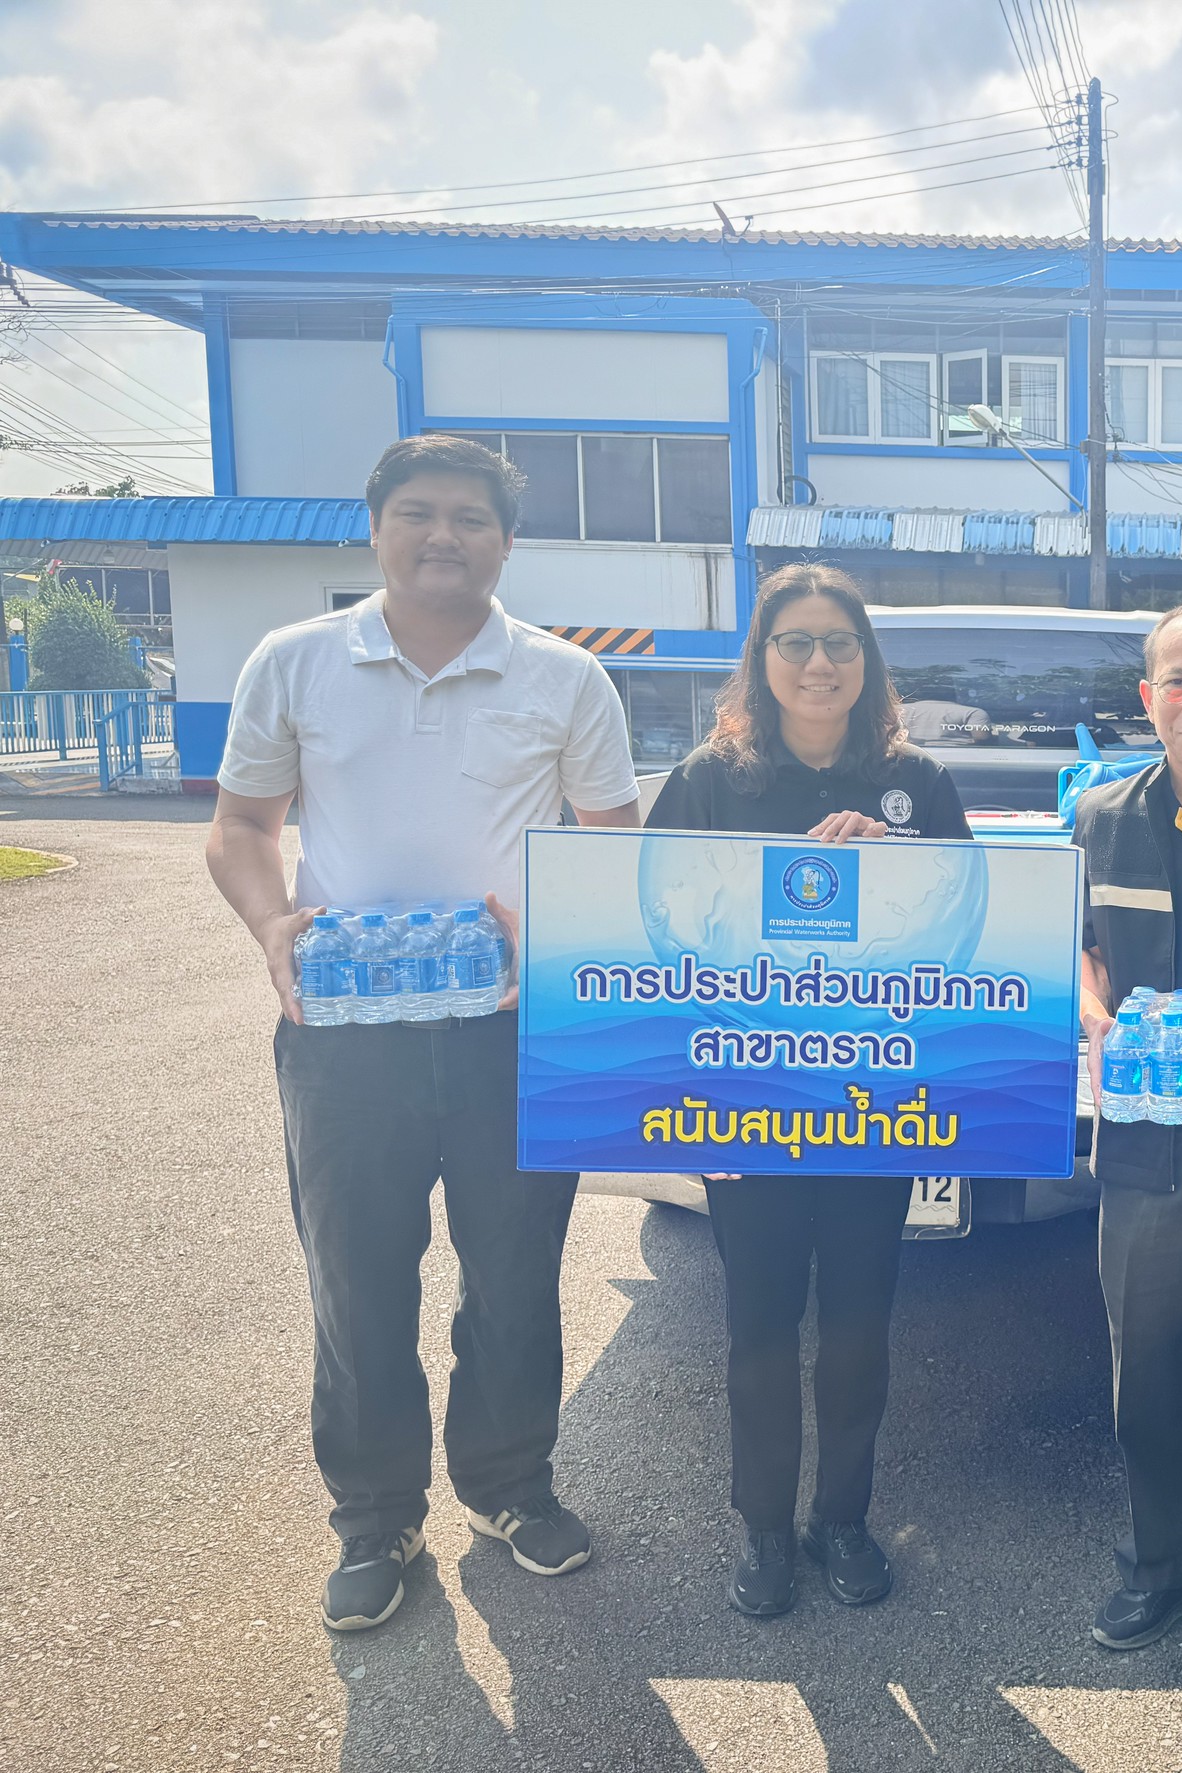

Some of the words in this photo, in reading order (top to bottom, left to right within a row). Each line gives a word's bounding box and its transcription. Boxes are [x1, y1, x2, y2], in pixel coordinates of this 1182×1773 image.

[941, 723, 990, 732] TOYOTA
[995, 724, 1056, 733] PARAGON
[769, 918, 851, 929] การประปาส่วนภูมิภาค
[574, 953, 1027, 1020] การประปาส่วนภูมิภาค
[692, 1028, 915, 1068] สาขาตราด
[642, 1085, 959, 1159] สนับสนุนน้ำดื่ม
[918, 1176, 952, 1202] 12
